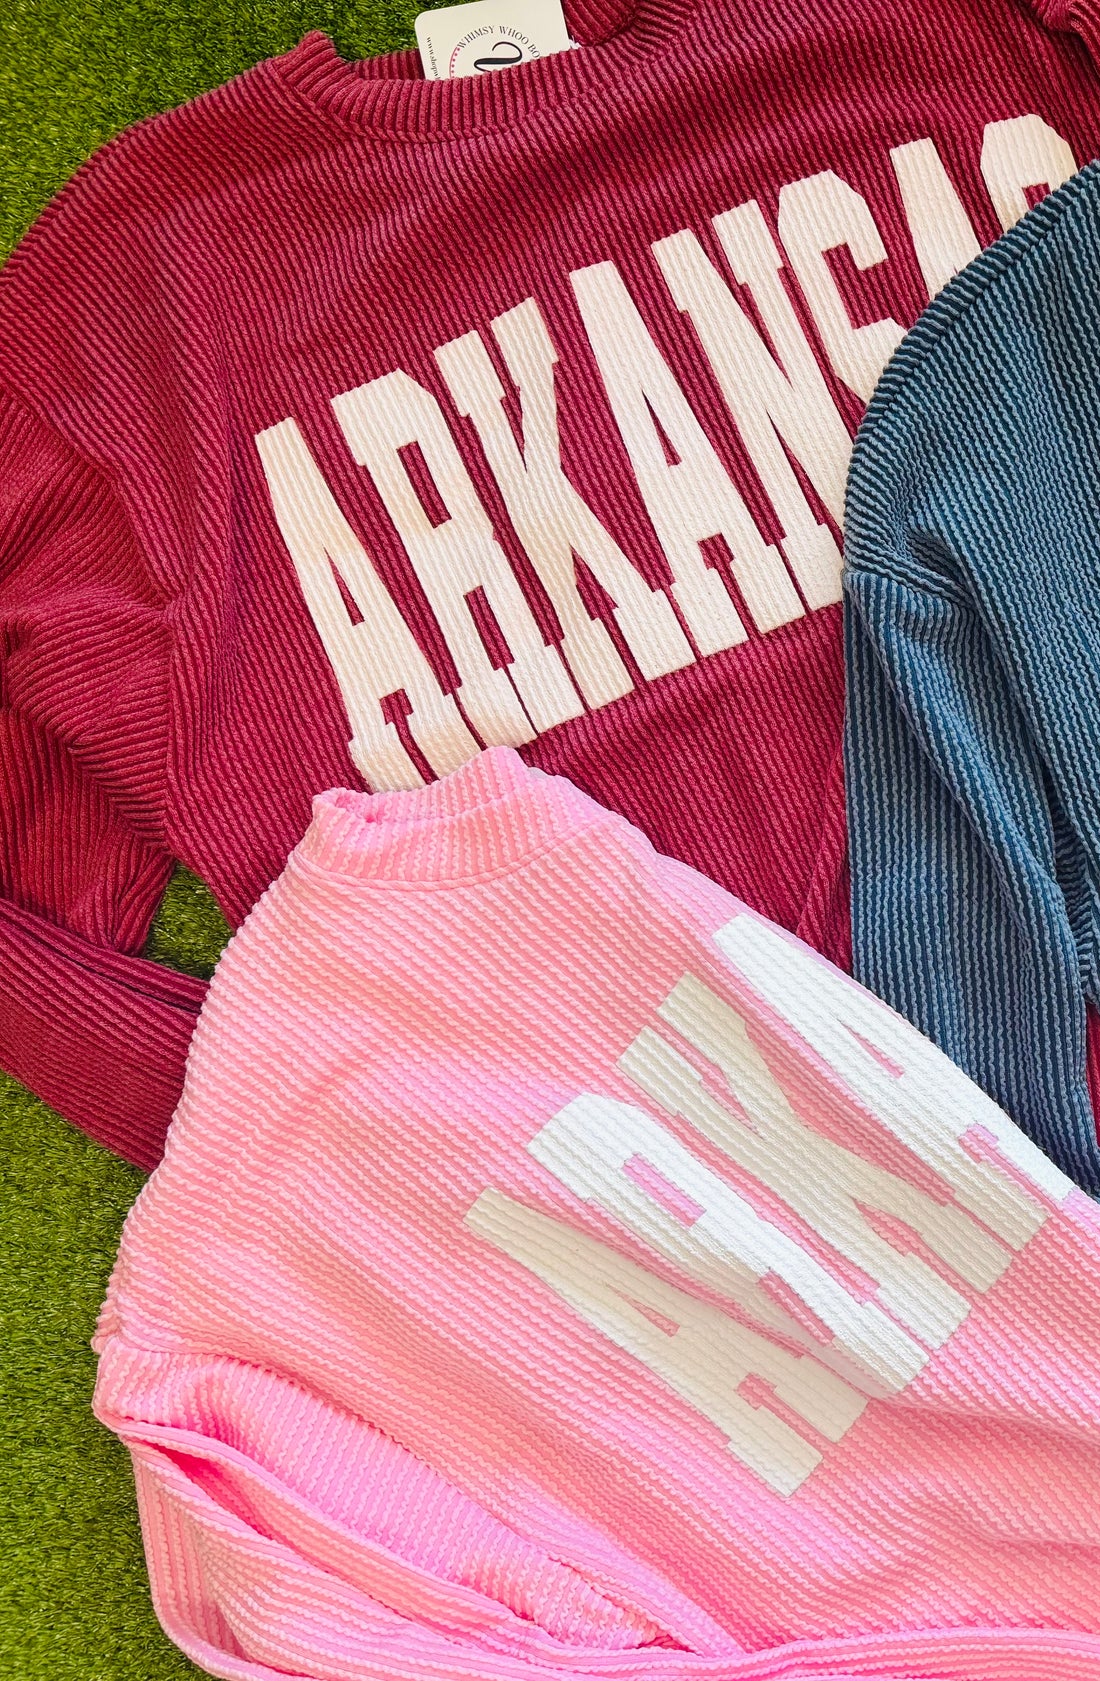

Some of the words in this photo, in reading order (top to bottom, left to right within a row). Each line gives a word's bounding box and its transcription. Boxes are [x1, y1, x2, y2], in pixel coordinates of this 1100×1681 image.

[457, 25, 495, 49] WHIMSY
[499, 25, 530, 46] WHOO
[255, 113, 1080, 793] ARKANS
